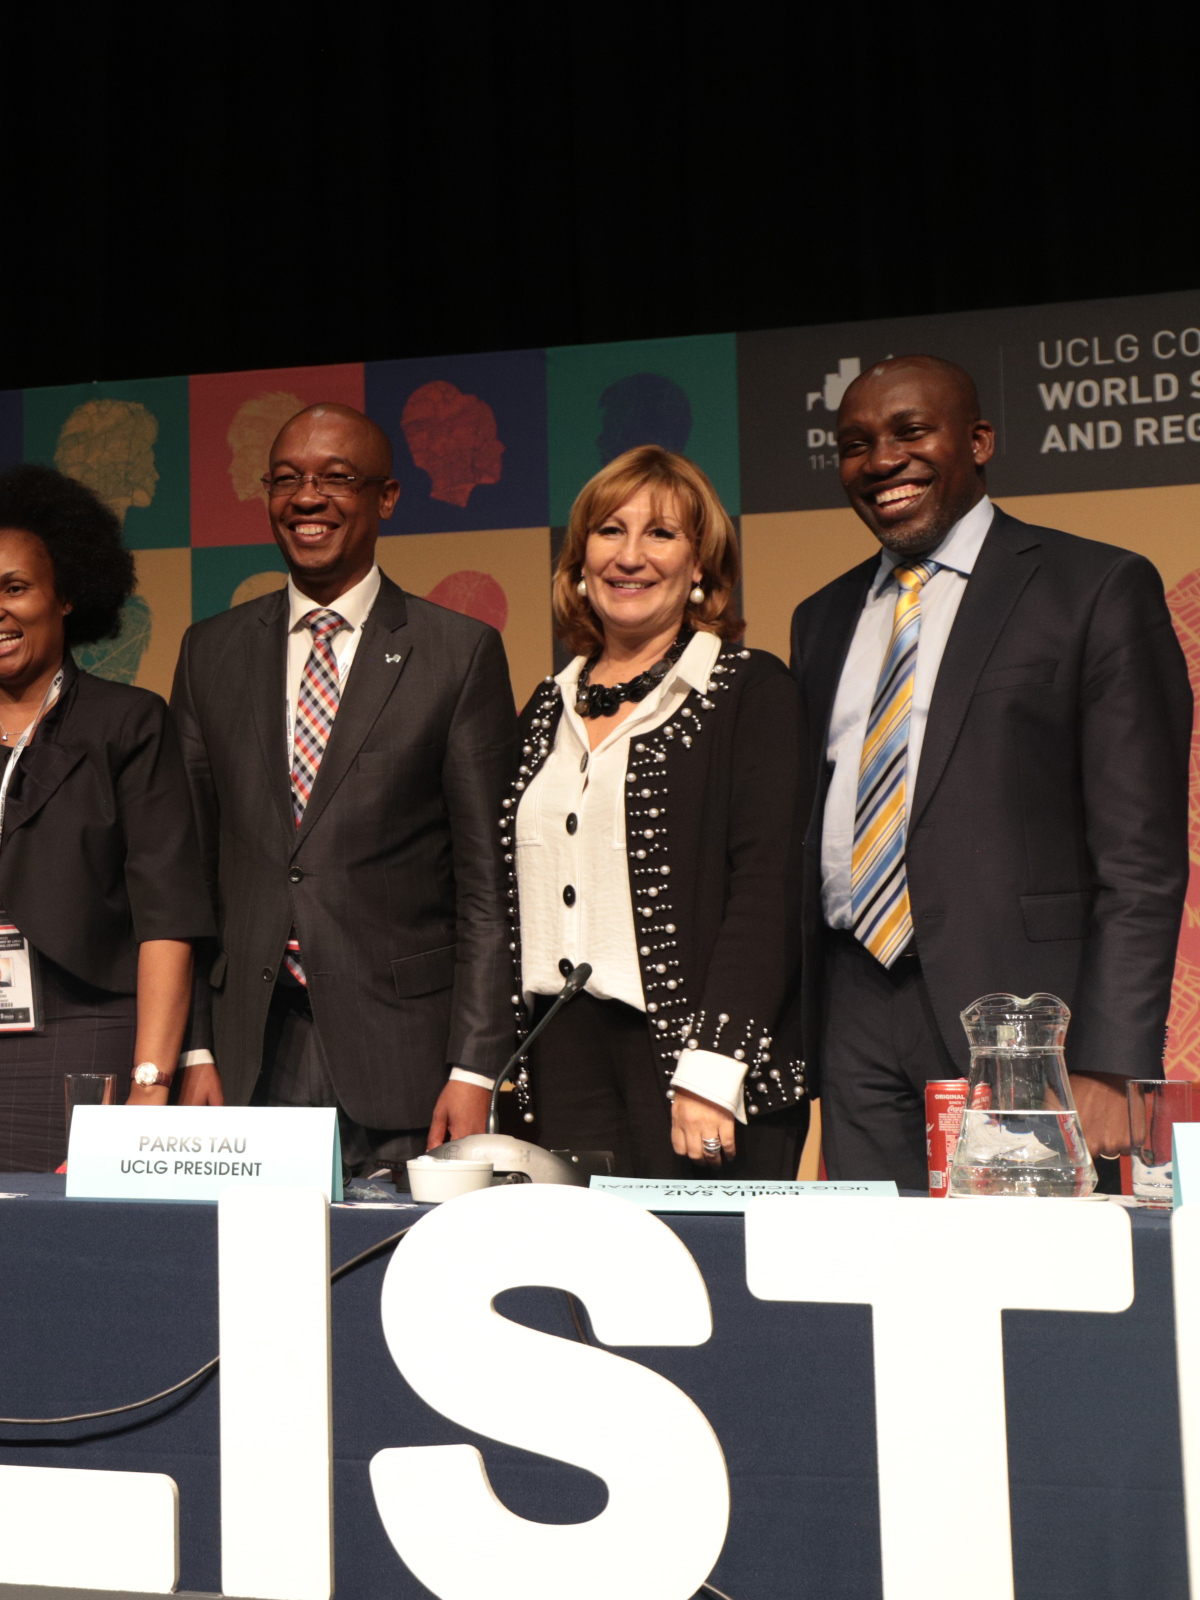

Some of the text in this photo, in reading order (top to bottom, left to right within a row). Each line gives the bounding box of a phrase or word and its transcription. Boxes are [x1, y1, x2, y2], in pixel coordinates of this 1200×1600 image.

[1038, 327, 1200, 369] UCLG CO
[1037, 373, 1179, 412] WORLD
[1040, 420, 1123, 453] AND
[139, 1136, 247, 1153] PARKS TAU
[120, 1160, 262, 1176] UCLG PRESIDENT
